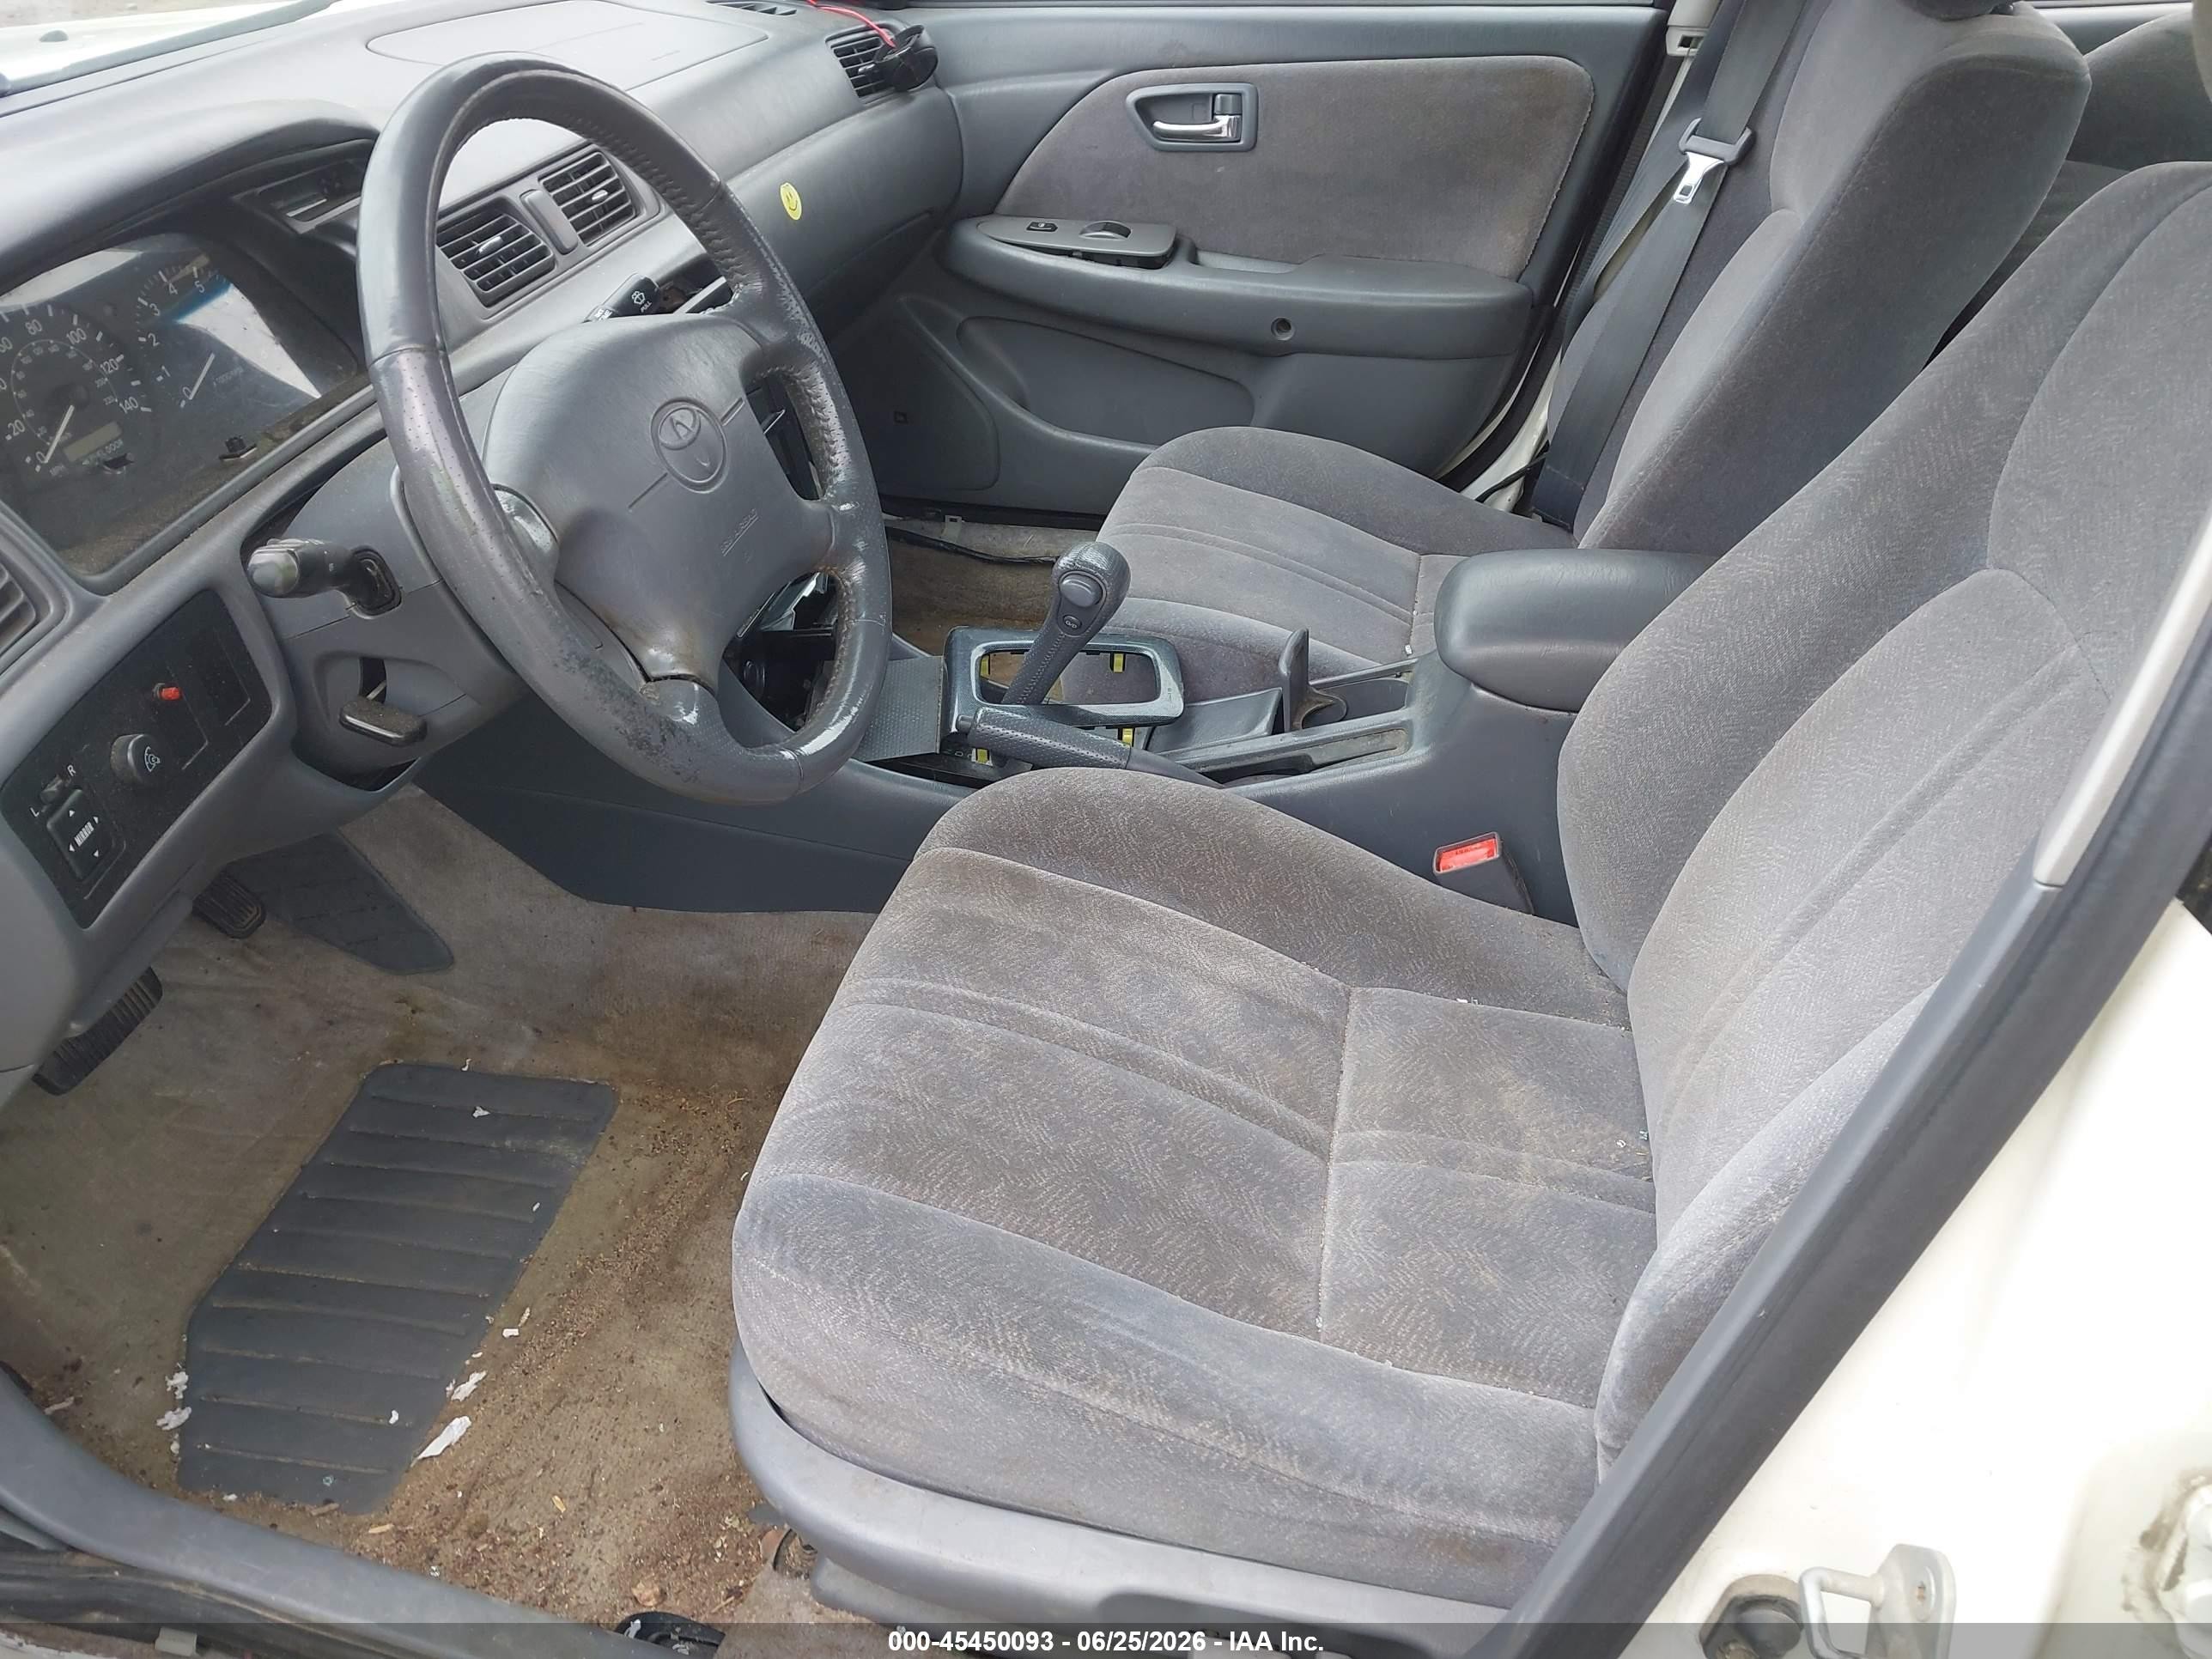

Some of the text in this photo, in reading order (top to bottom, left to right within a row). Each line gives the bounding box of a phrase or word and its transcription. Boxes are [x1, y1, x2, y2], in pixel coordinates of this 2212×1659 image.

[169, 283, 178, 295] 4
[194, 281, 205, 293] 5
[149, 303, 161, 316] 3
[25, 319, 42, 335] 80
[66, 328, 87, 344] 100
[148, 333, 160, 346] 2
[100, 358, 118, 374] 120
[118, 396, 138, 414] 140
[7, 419, 25, 436] 20
[67, 764, 76, 776] R
[30, 807, 40, 817] L
[74, 821, 94, 847] MIRROR
